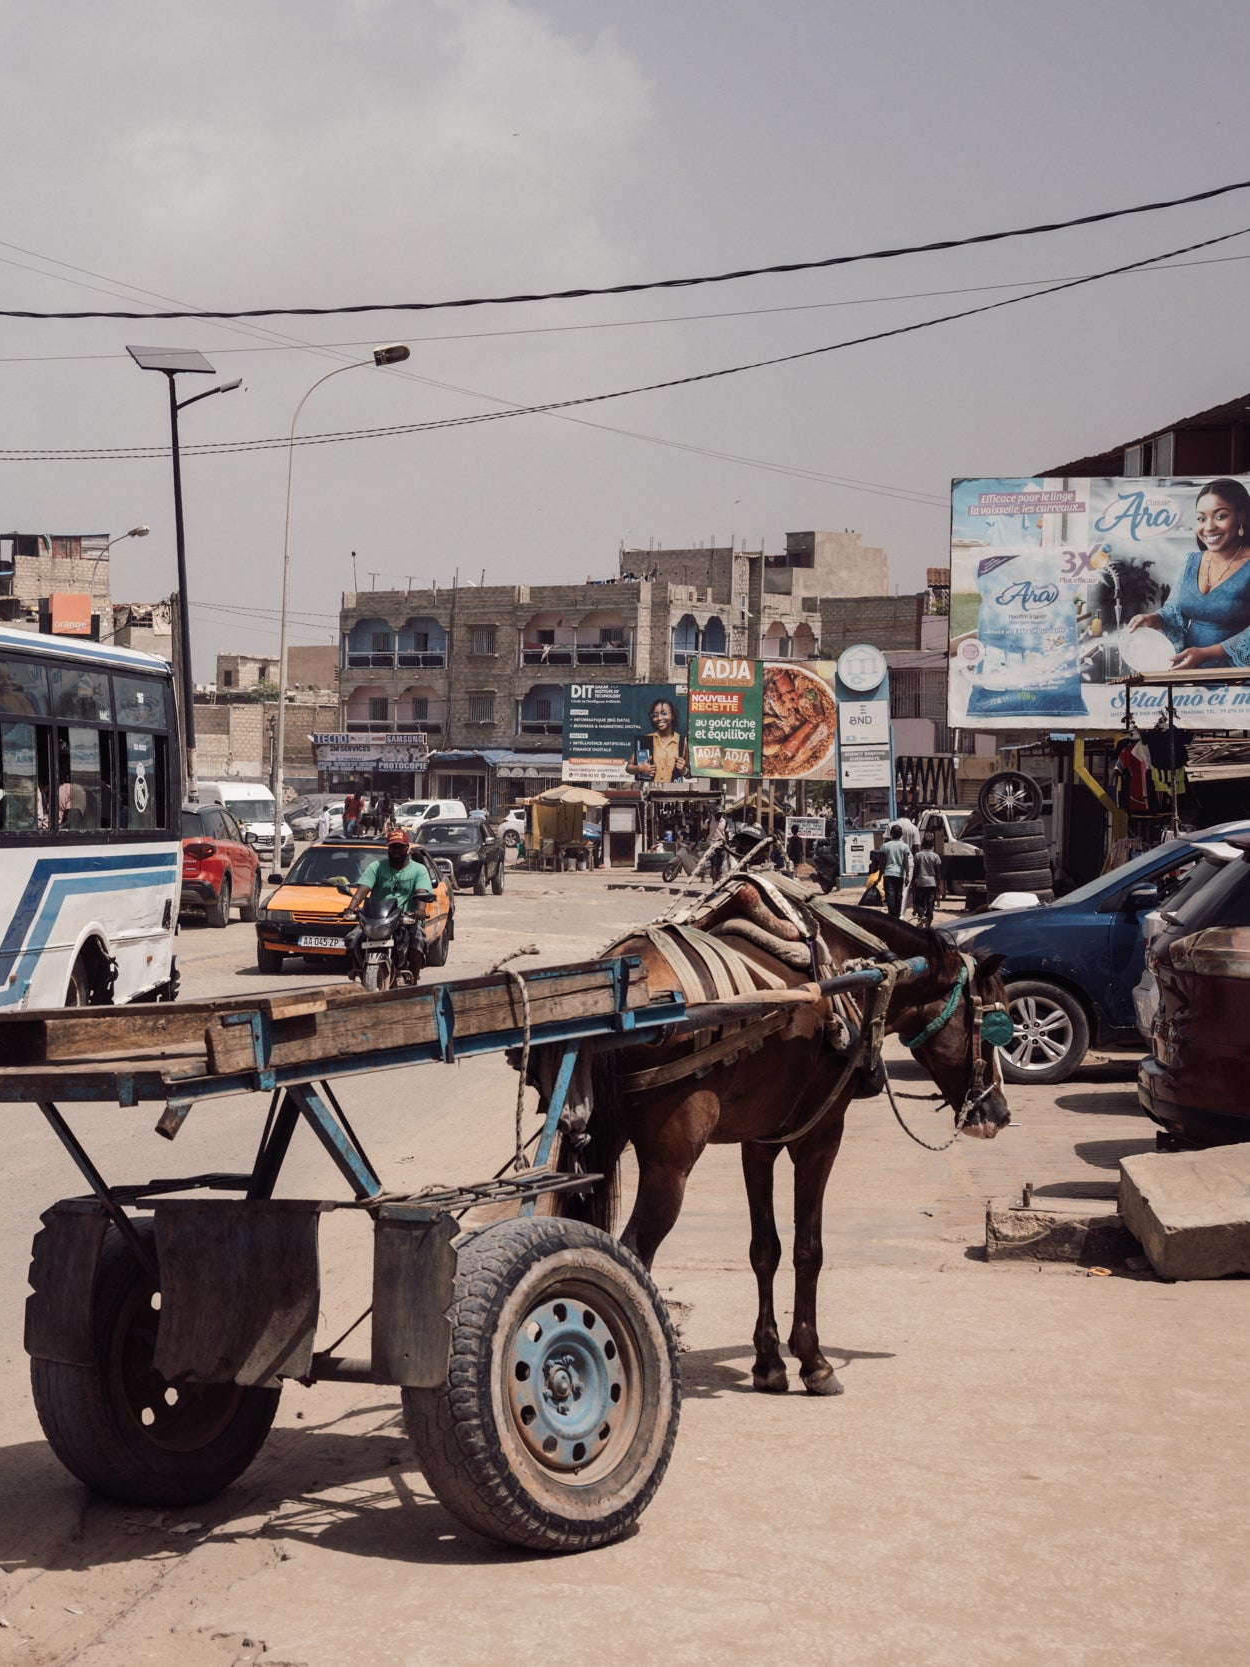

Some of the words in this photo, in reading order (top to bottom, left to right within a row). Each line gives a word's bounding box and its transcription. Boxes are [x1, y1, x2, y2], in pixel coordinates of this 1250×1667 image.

[981, 493, 1017, 504] Efficace
[1017, 495, 1040, 504] pour
[1041, 492, 1050, 502] le
[1050, 492, 1073, 503] linge
[1145, 499, 1172, 507] Classic
[970, 506, 979, 515] la
[980, 504, 1021, 515] vaisselle,
[1021, 504, 1036, 513] les
[1094, 491, 1179, 541] Ara
[995, 581, 1055, 611] Ara
[54, 620, 87, 630] orange
[702, 660, 750, 680] ADJA
[571, 684, 594, 698] DIT
[692, 694, 738, 703] NOUVELLE
[691, 702, 738, 712] RECETTE
[695, 719, 707, 727] au
[708, 717, 731, 730] goût
[732, 718, 756, 728] riche
[849, 715, 873, 725] BND
[317, 734, 349, 744] TECNO
[386, 735, 423, 743] SAMSUNG
[695, 730, 706, 739] et
[708, 729, 756, 741] équilibré
[697, 747, 721, 758] ADJA
[724, 750, 750, 763] ADJA
[378, 762, 428, 770] PHOTOCOPIE
